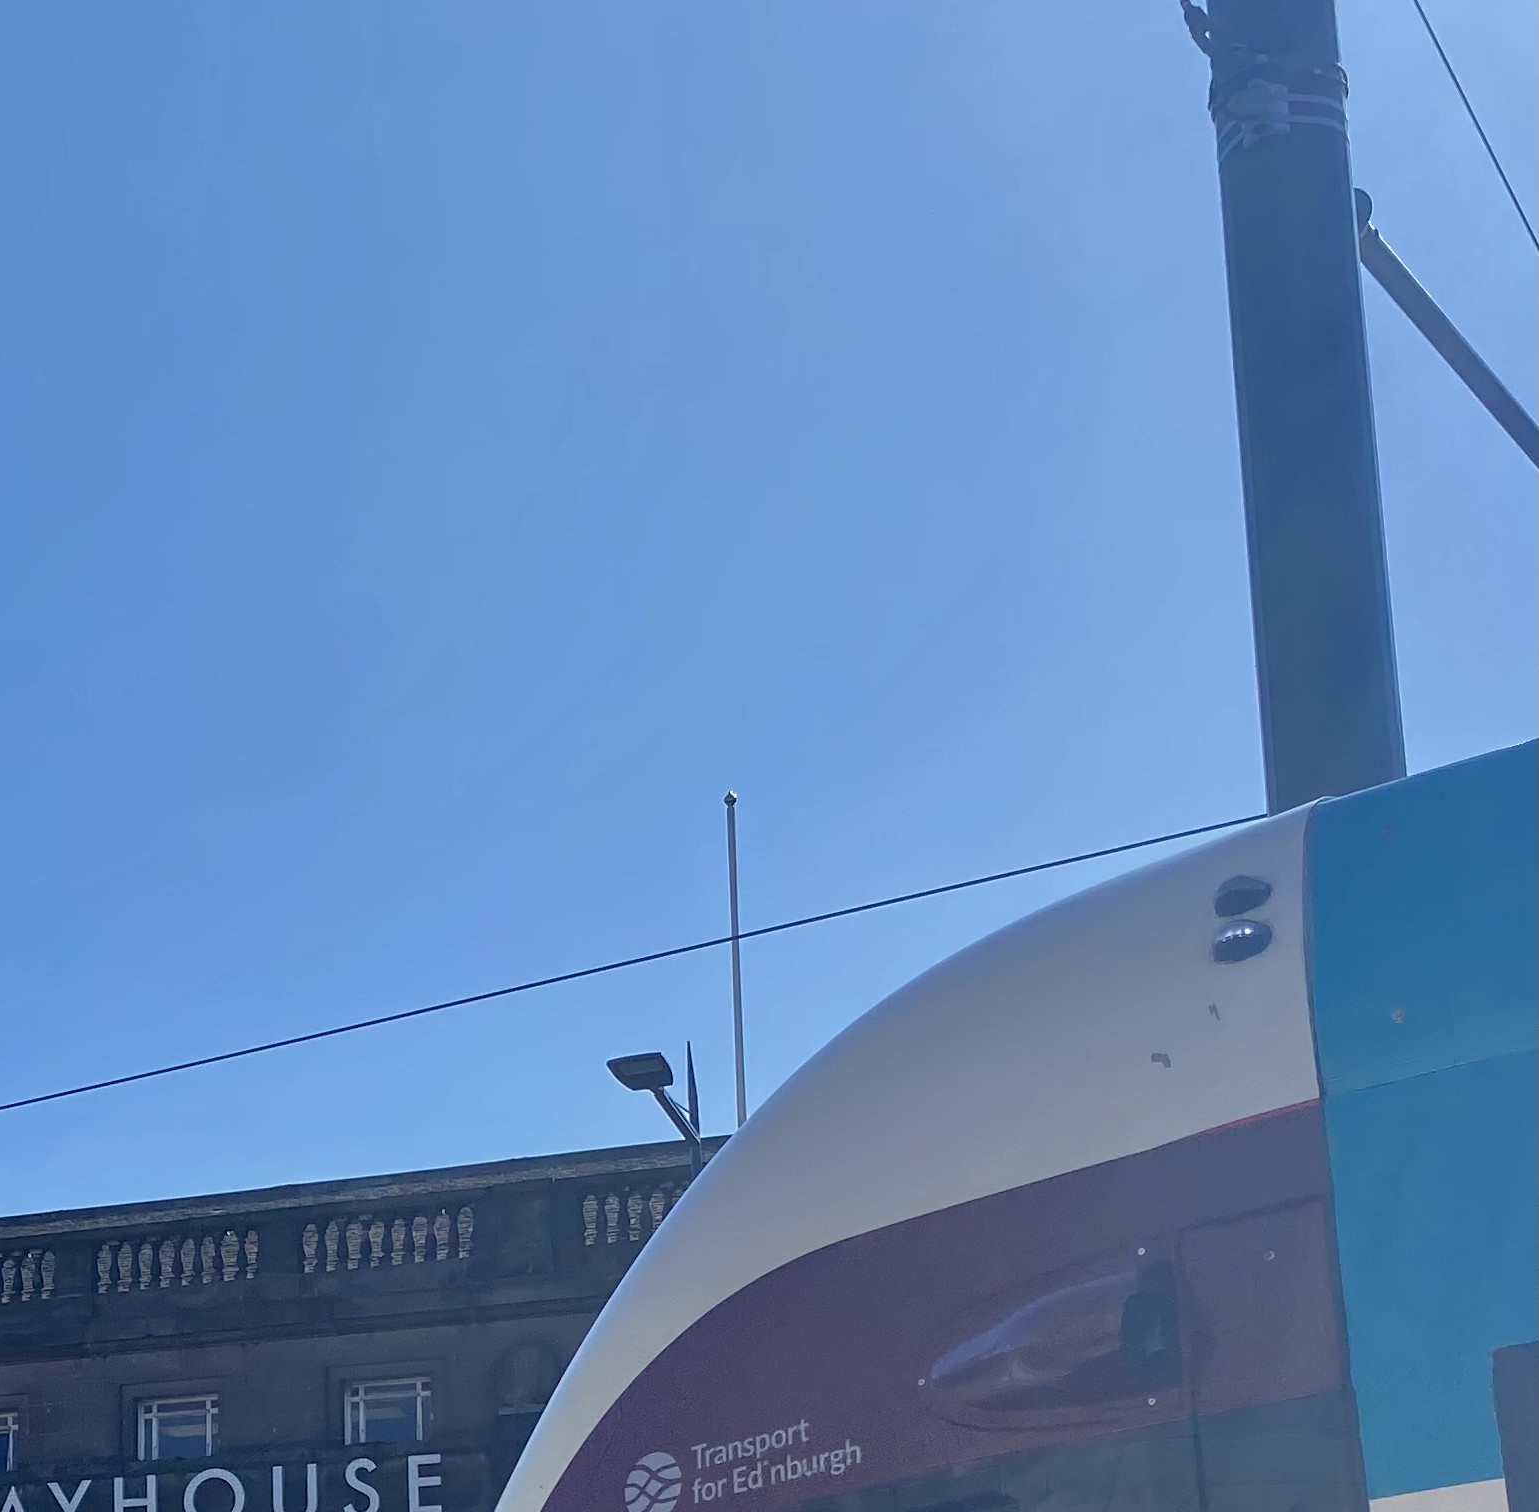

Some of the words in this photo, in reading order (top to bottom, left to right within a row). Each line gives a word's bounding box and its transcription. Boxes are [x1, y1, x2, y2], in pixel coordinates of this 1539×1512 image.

[691, 1419, 810, 1469] Transport
[692, 1477, 727, 1504] for
[733, 1439, 862, 1495] Ednburgh
